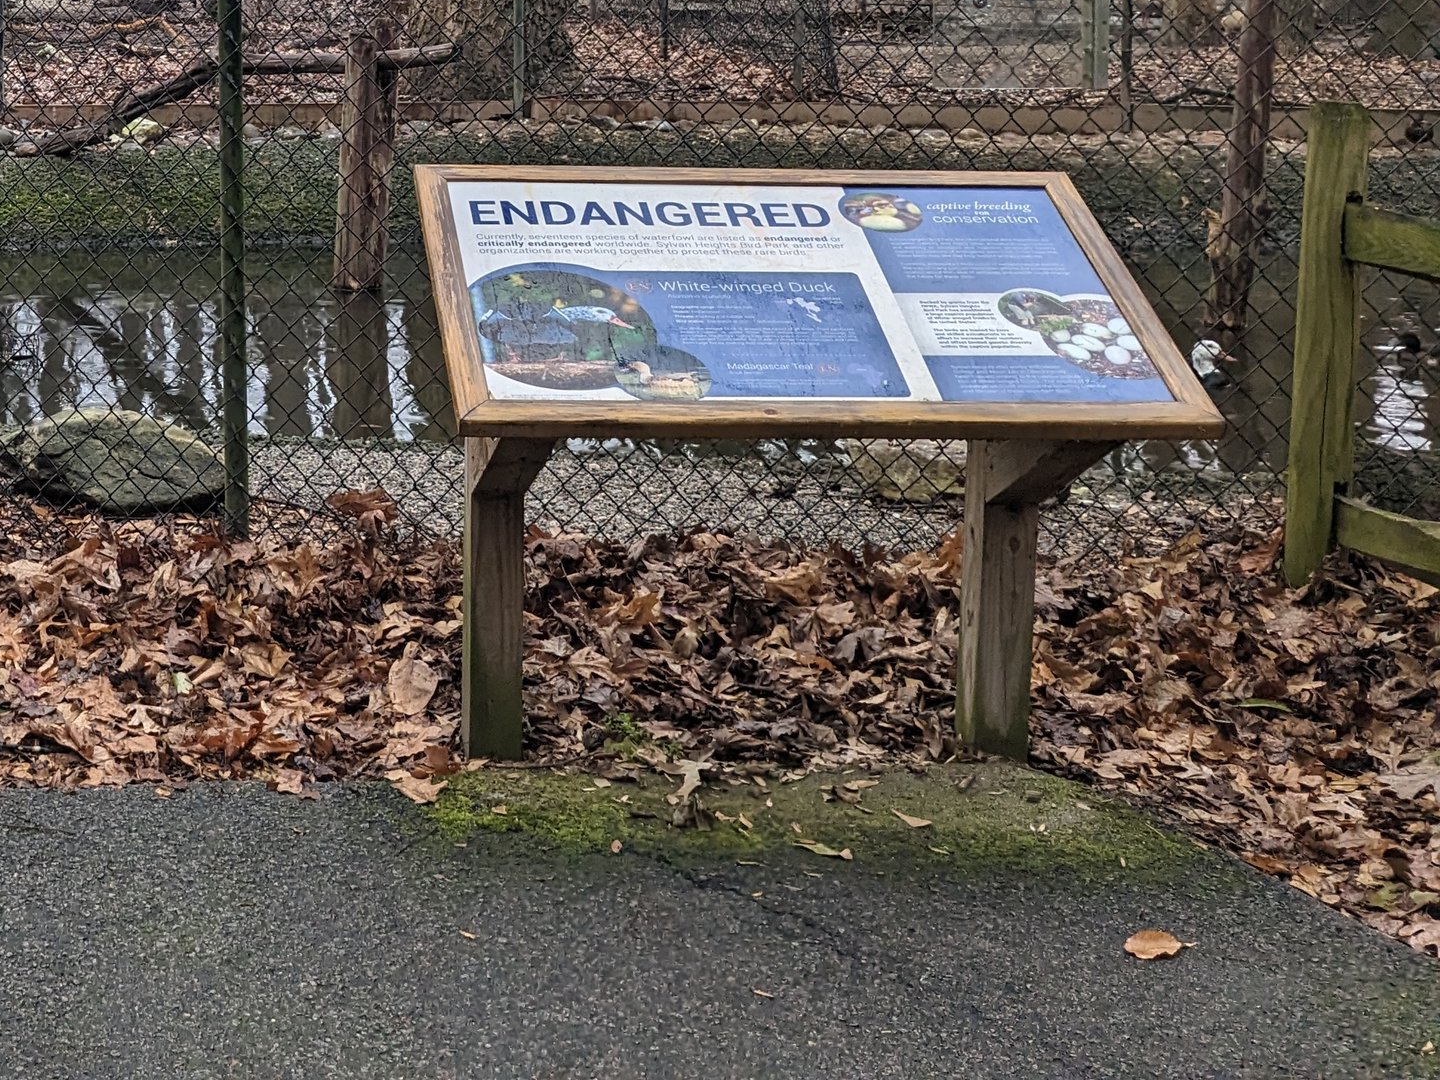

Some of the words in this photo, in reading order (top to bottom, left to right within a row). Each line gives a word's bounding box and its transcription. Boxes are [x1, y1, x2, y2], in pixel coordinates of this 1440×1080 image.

[926, 201, 971, 212] captive
[974, 201, 1032, 213] breeding
[468, 200, 831, 227] ENDANGERED
[932, 214, 1040, 224] conservation
[476, 233, 527, 241] Currently,
[694, 241, 736, 249] Heights
[619, 248, 664, 256] together
[658, 281, 785, 295] White-winged
[788, 281, 836, 293] Duck
[726, 362, 790, 372] Madagascar
[792, 362, 814, 370] Teal
